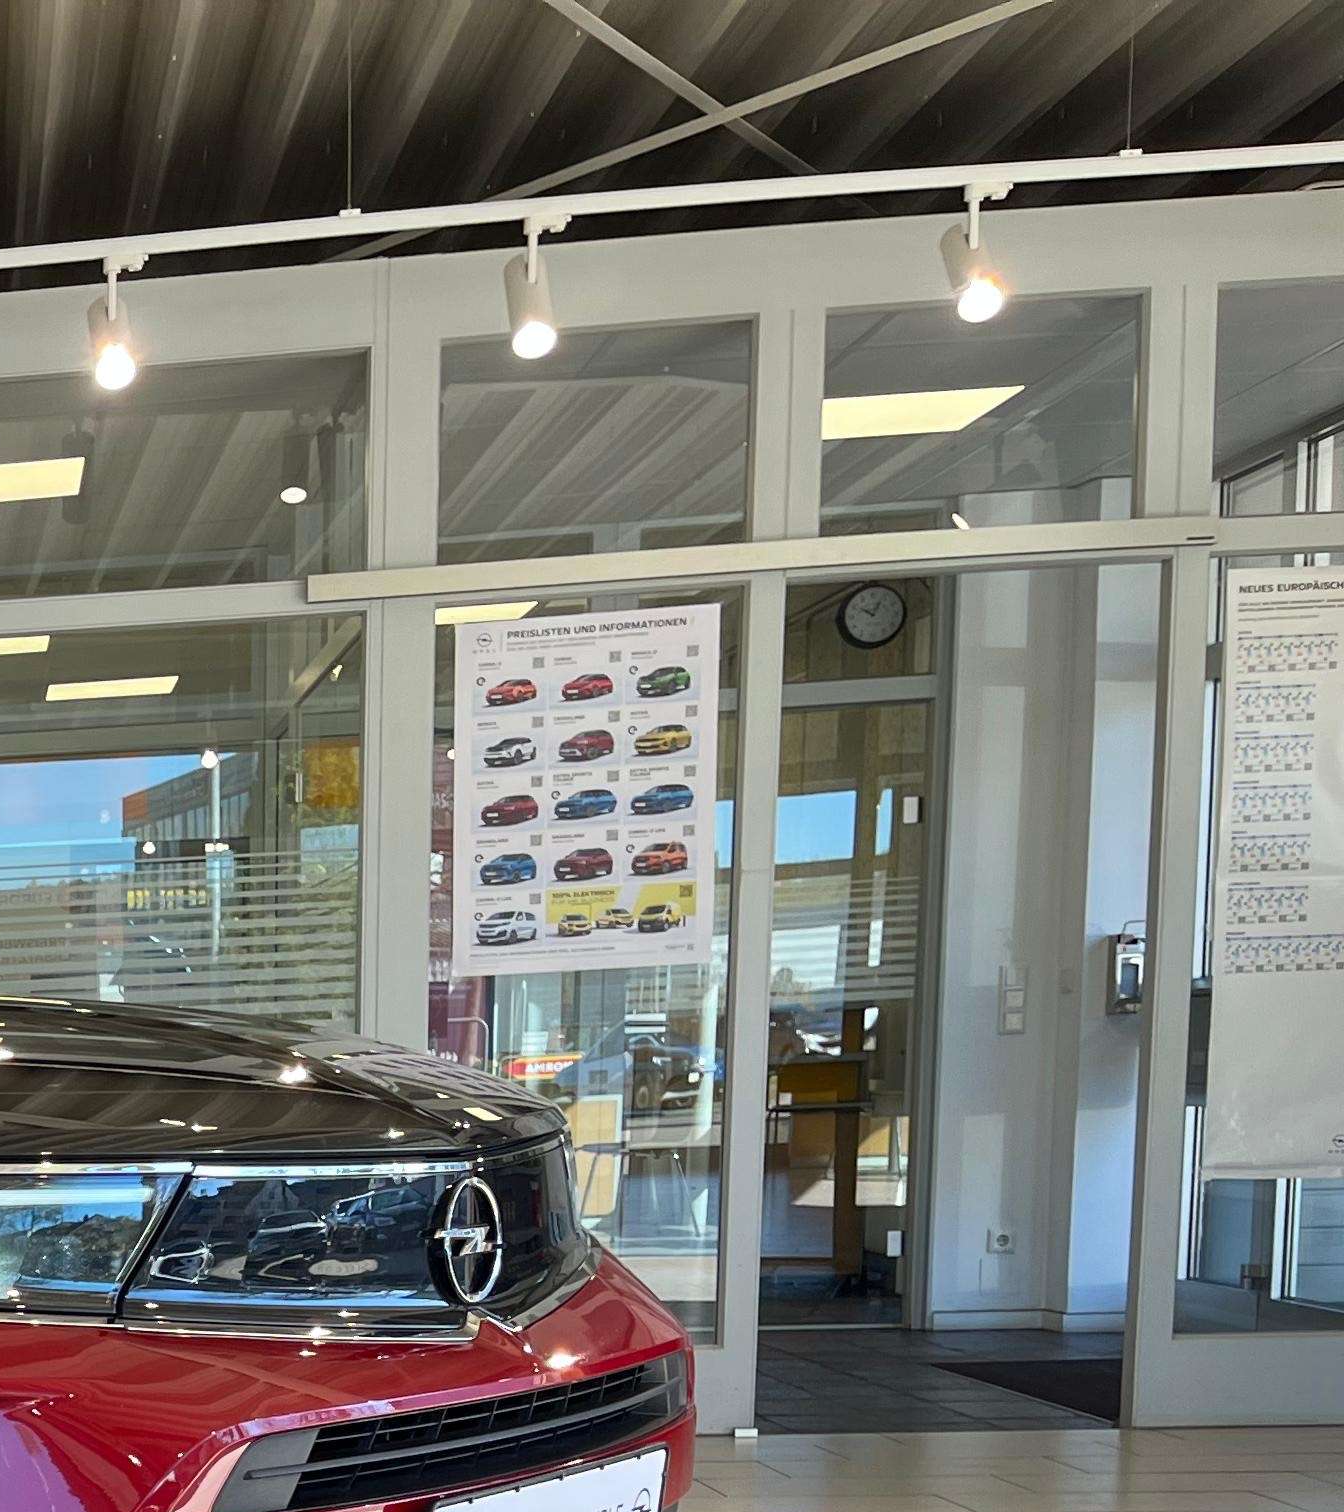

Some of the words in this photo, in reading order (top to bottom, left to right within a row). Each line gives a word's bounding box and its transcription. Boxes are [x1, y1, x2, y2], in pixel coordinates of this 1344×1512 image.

[1238, 584, 1274, 594] NEUES
[506, 627, 571, 639] PREISLISTEN
[574, 624, 597, 634] UND
[599, 617, 688, 632] INFORMATIONEN
